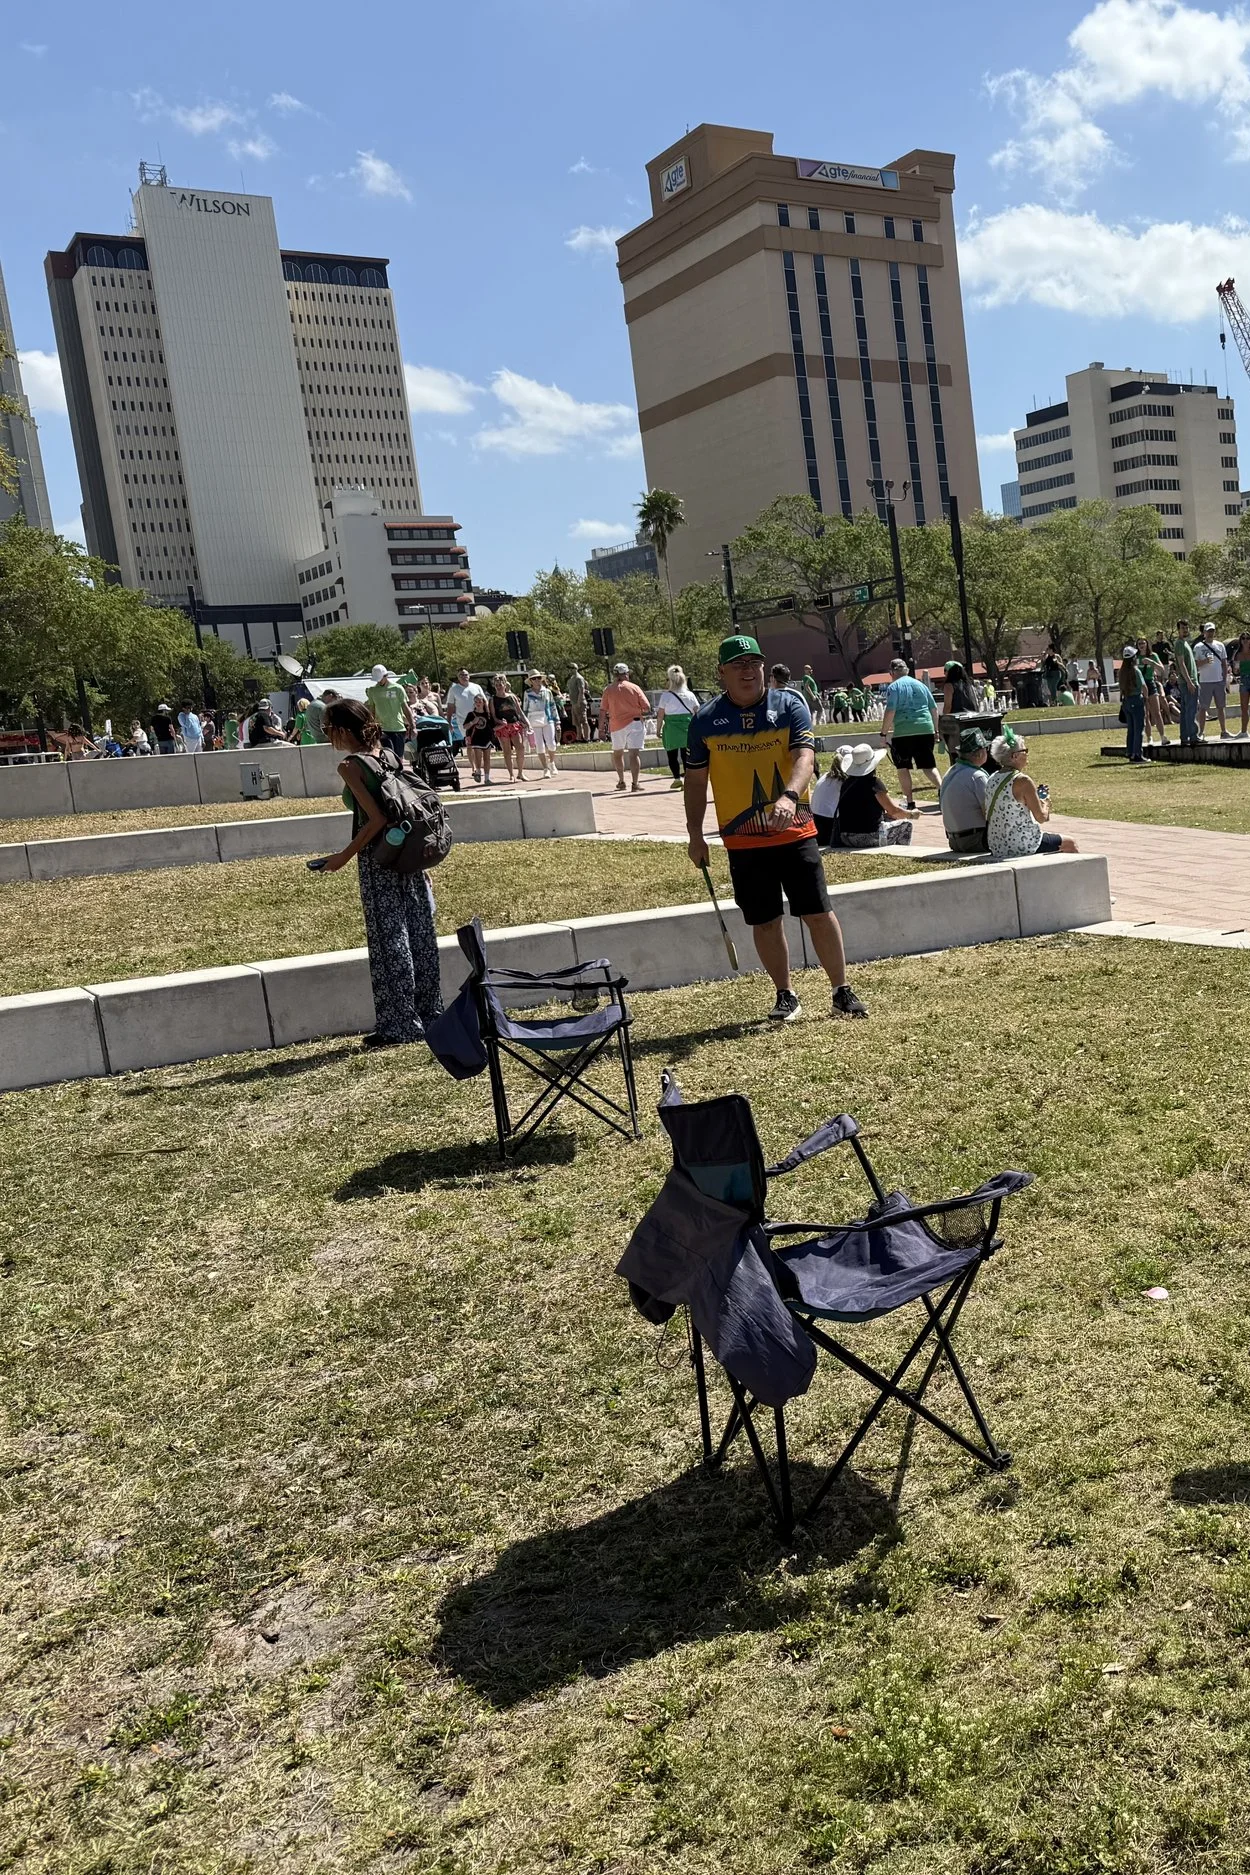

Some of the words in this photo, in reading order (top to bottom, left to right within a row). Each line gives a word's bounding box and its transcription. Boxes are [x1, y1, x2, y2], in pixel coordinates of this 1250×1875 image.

[847, 170, 880, 181] financial
[170, 191, 250, 216] WILSON
[742, 718, 755, 729] 12
